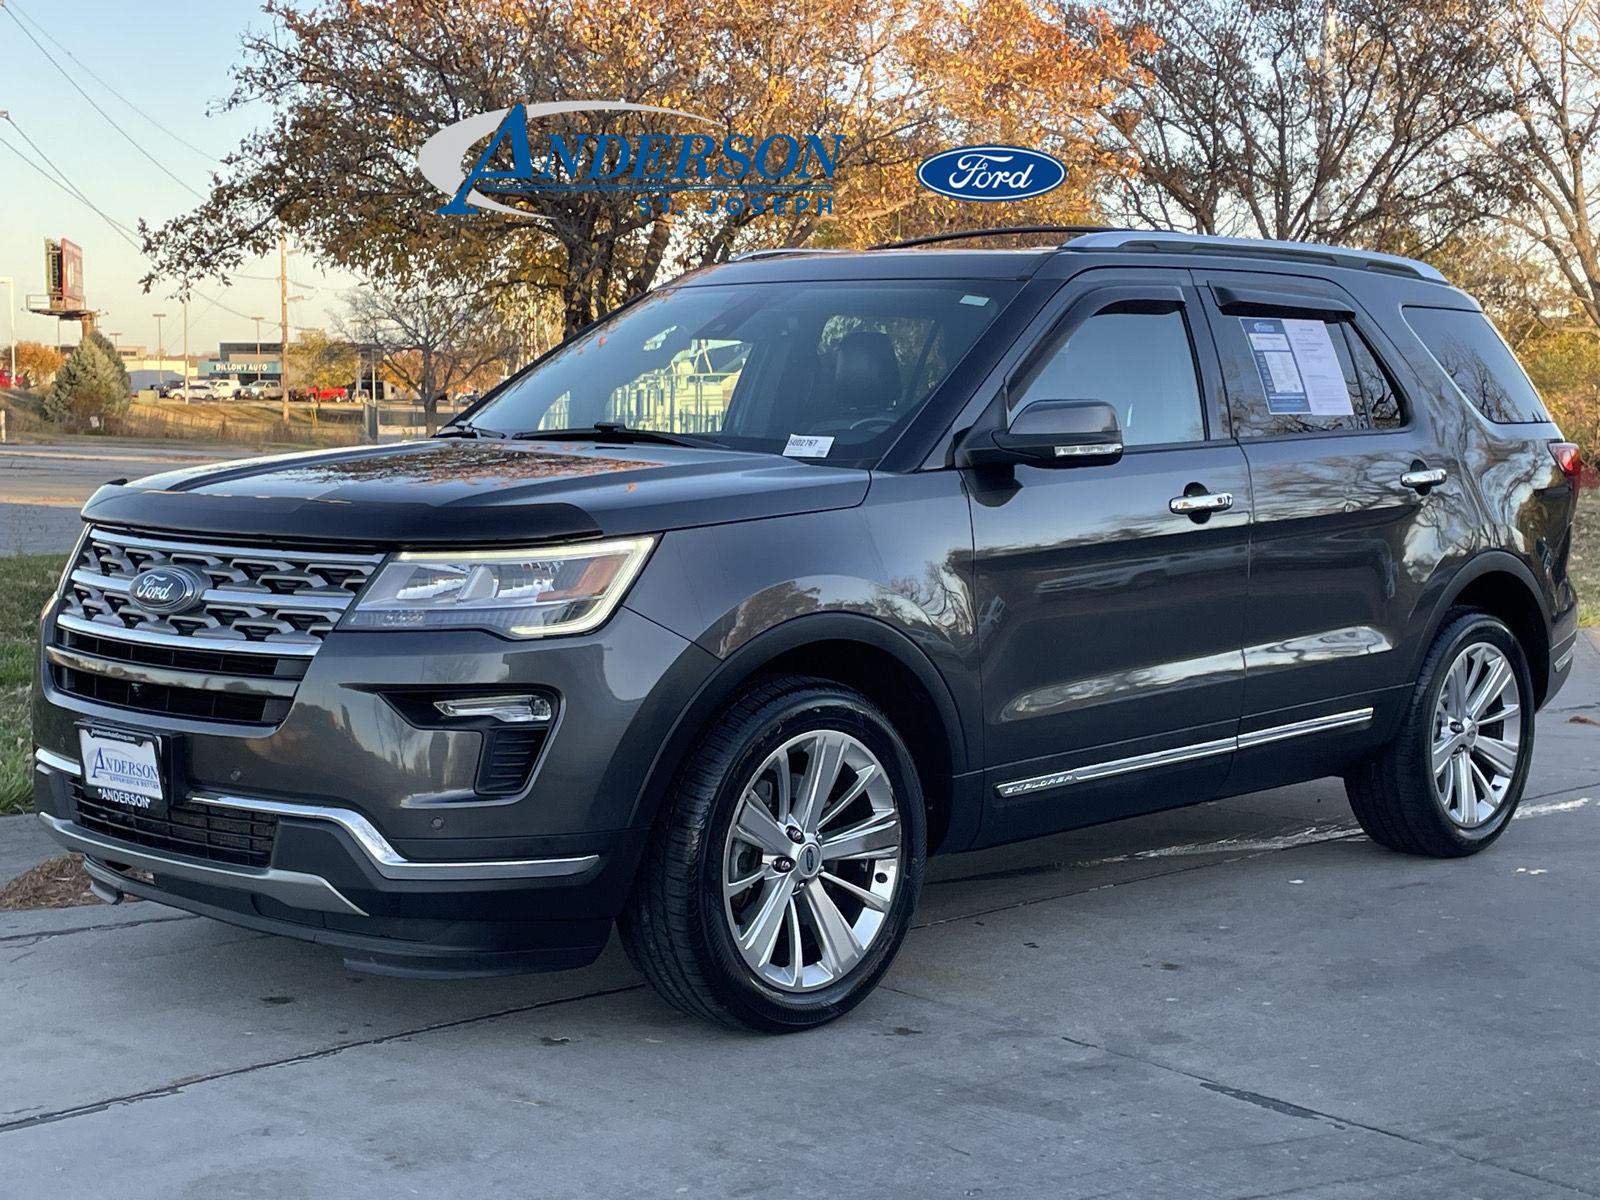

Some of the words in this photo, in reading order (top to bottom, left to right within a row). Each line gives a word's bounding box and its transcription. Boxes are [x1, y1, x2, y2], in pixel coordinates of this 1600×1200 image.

[136, 574, 174, 600] Ford
[91, 747, 158, 780] ANDERSON
[1004, 775, 1073, 794] EXPLORER
[101, 788, 149, 809] ANDERSON
